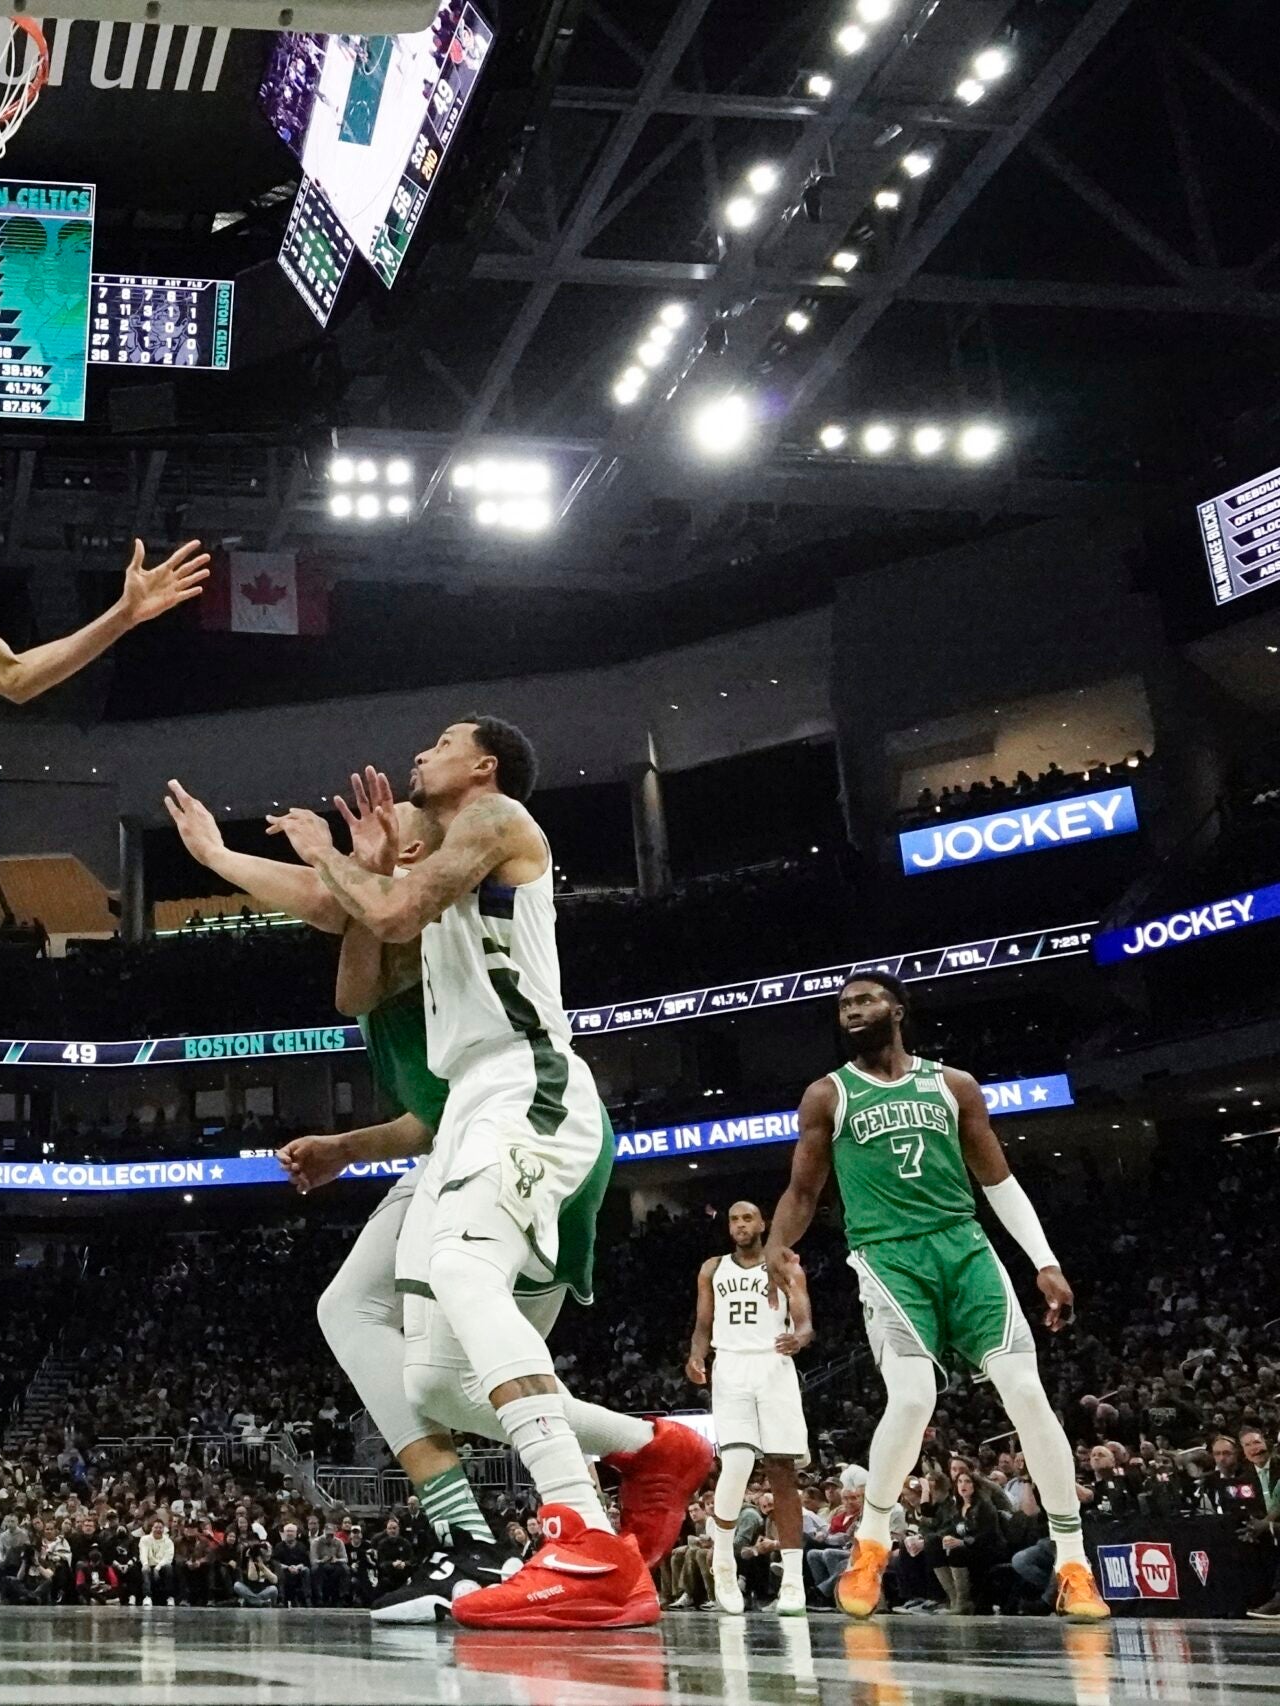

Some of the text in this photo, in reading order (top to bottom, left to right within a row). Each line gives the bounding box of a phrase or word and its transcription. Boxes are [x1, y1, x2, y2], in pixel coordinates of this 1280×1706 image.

[433, 79, 454, 115] 49
[411, 134, 430, 170] 3:04
[421, 149, 438, 181] 2ND
[16, 187, 90, 212] CELTICS
[392, 185, 412, 220] 56
[98, 287, 108, 299] 7
[144, 289, 154, 301] 7
[120, 304, 131, 316] 11
[143, 305, 153, 317] 3
[94, 318, 197, 335] 12 2 4 0 0
[215, 284, 230, 368] BOSTON CELTICS
[92, 334, 197, 350] 27 7 0
[118, 350, 128, 362] 3
[141, 352, 150, 363] 0
[164, 353, 173, 364] 2
[1, 364, 44, 378] 39.5%
[5, 382, 43, 395] 41.7%
[2, 400, 42, 414] 87.5%
[1234, 511, 1253, 527] OFF
[1201, 503, 1233, 601] MILWAUKEE BUCKS
[912, 794, 1123, 868] JOCKEY
[1123, 895, 1255, 954] JOCKEY
[579, 1014, 602, 1029] FG
[614, 1007, 654, 1024] 39.5%
[664, 998, 697, 1016] 3PT
[711, 991, 748, 1007] 41.7%
[762, 982, 784, 999] FT
[803, 974, 846, 992] 87.5%
[914, 960, 922, 973] 1
[947, 949, 985, 968] TOL
[1008, 944, 1020, 957] 4
[1051, 934, 1079, 950] 7:23
[61, 1043, 97, 1064] 49
[184, 1034, 265, 1060] BOSTON
[272, 1029, 346, 1053] CELTICS
[849, 1100, 949, 1145] CELTICS
[674, 1126, 701, 1149] IN
[890, 1133, 925, 1179] 7
[52, 1162, 204, 1187] COLLECTION
[716, 1277, 769, 1299] BUCKS
[729, 1301, 758, 1326] 22
[1104, 1556, 1170, 1588] NBA TNT
